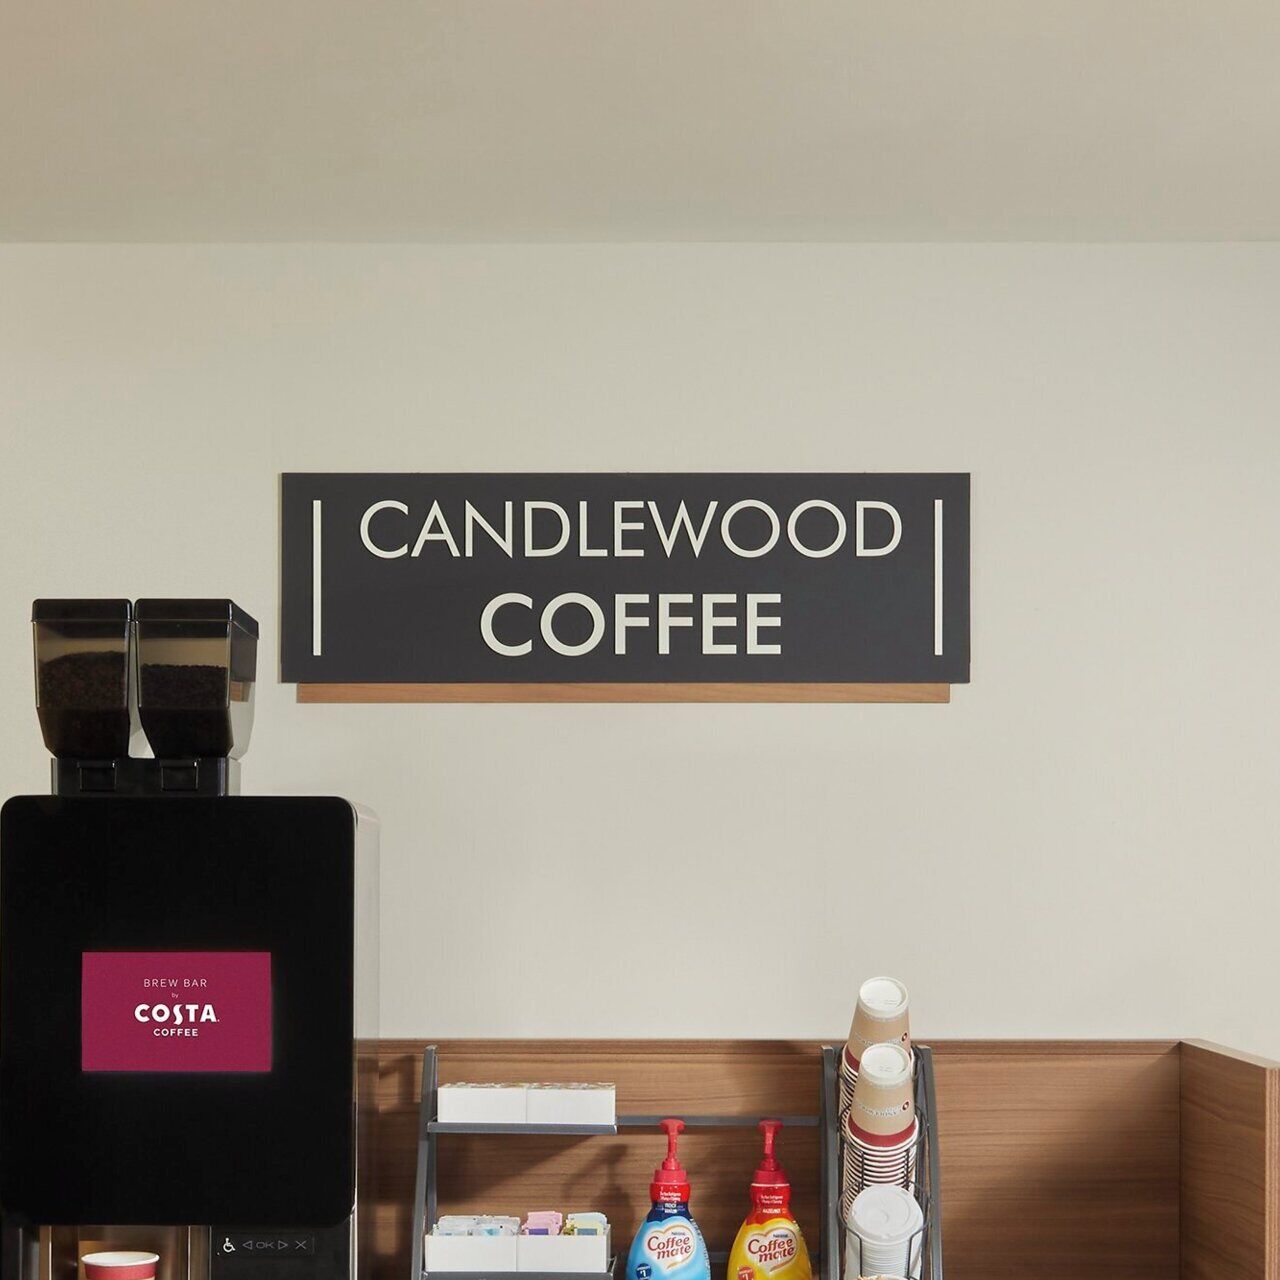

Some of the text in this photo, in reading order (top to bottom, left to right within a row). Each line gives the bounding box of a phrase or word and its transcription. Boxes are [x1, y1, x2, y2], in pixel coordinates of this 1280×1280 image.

[360, 499, 903, 558] CANDLEWOOD
[480, 592, 782, 657] COFFEE
[144, 978, 208, 988] BREW BAR
[134, 1004, 217, 1026] COSTA
[153, 1028, 199, 1037] COFFEE
[647, 1236, 690, 1251] Coffee
[748, 1238, 793, 1254] Coffee
[656, 1244, 691, 1260] mate
[758, 1246, 795, 1263] mate
